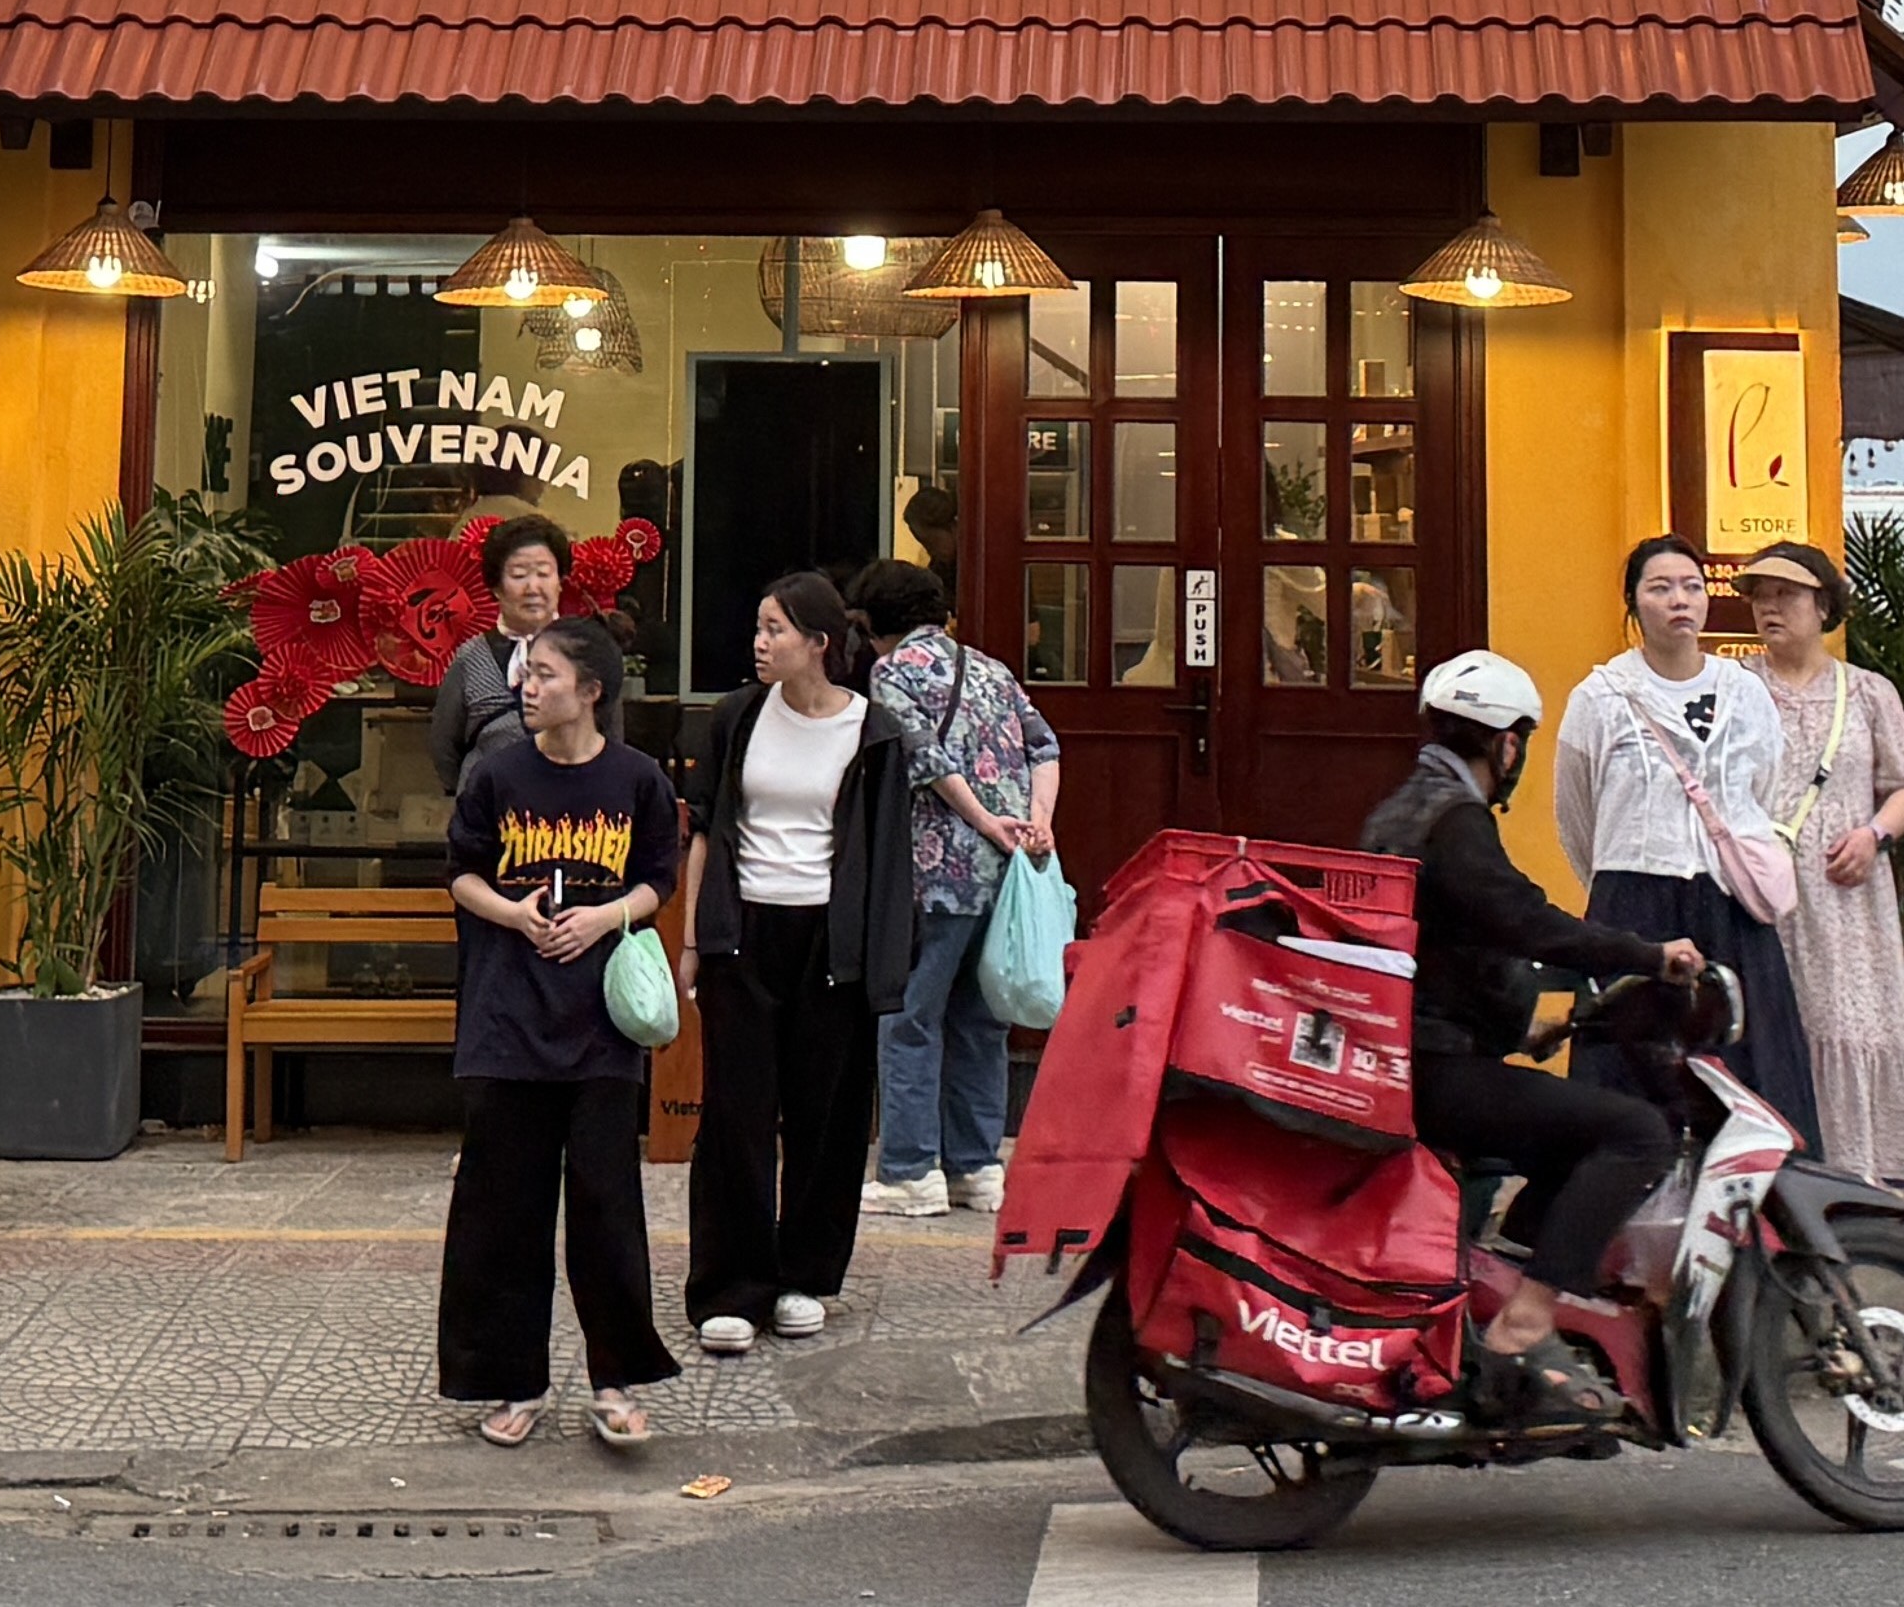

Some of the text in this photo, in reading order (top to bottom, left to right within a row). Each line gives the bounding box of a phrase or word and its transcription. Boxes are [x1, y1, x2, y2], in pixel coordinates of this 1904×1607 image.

[290, 368, 565, 429] VIET NAM
[269, 424, 590, 500] SOUVERNIA
[1194, 603, 1207, 661] PUSH
[498, 807, 632, 881] THRASHER
